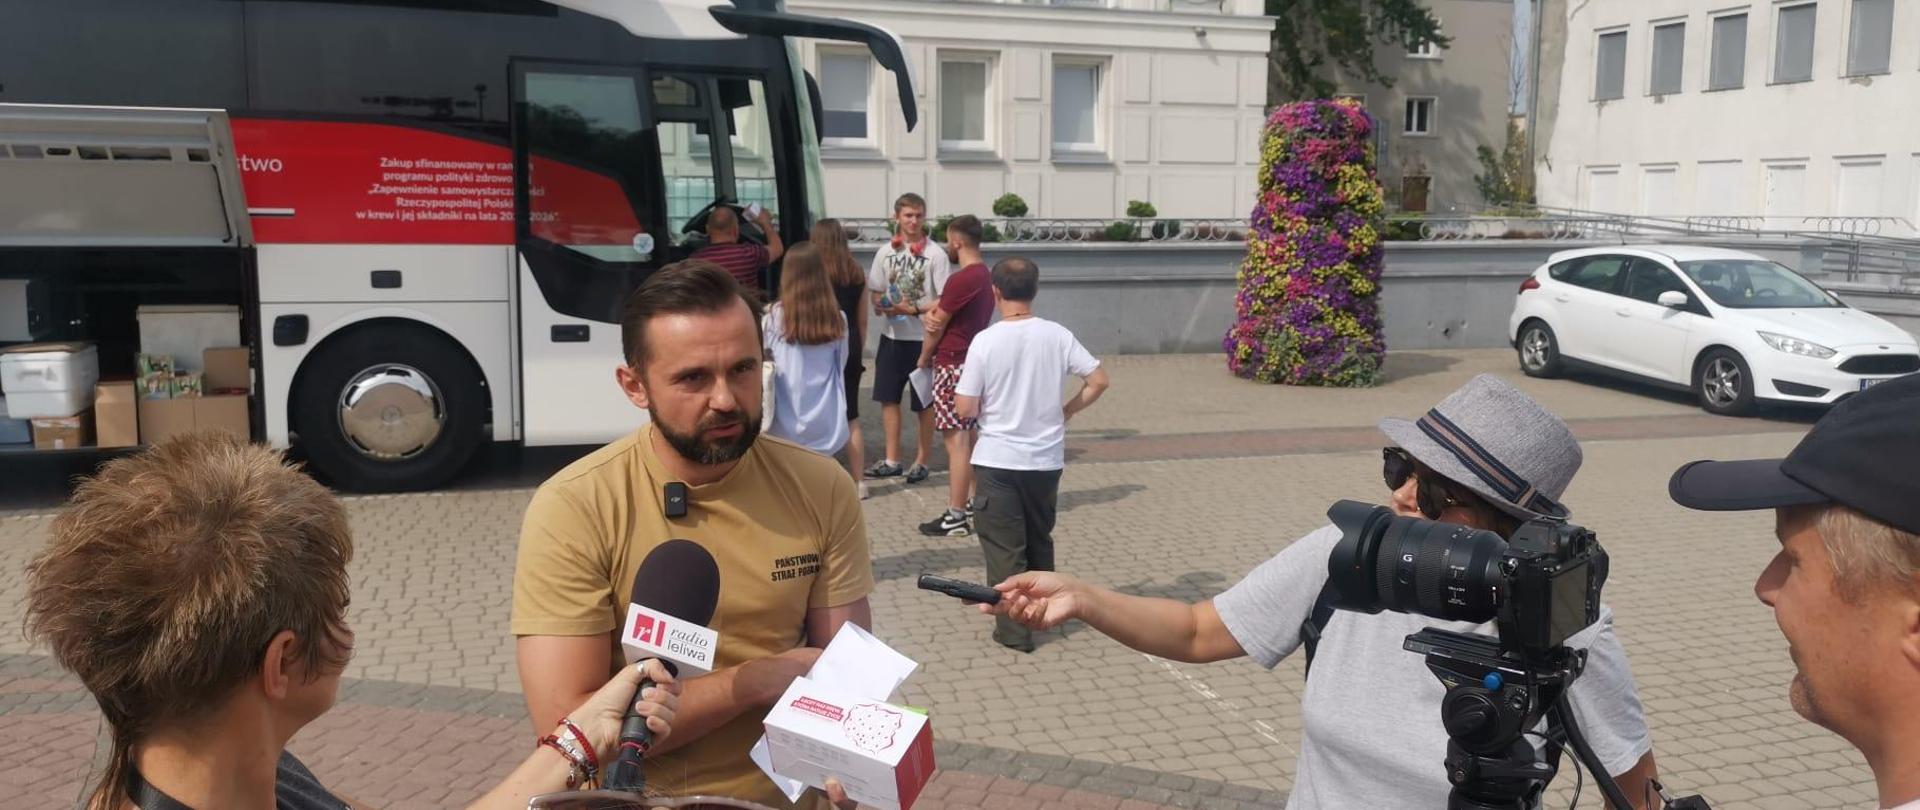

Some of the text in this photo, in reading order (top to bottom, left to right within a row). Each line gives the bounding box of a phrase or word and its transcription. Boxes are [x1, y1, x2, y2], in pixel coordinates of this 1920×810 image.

[380, 157, 413, 169] Zakup
[415, 158, 483, 170] sfinansowany
[486, 161, 495, 170] w
[383, 172, 433, 182] programu
[435, 171, 474, 183] polityki
[396, 197, 514, 209] Rzeczypospolitej Polski
[356, 210, 365, 219] w
[367, 209, 394, 219] krew
[397, 209, 400, 219] i
[401, 209, 415, 221] jej
[417, 209, 462, 221] składniki
[464, 212, 477, 221] na
[479, 210, 498, 221] lata
[885, 254, 930, 274] TMNT
[775, 554, 819, 568] PAŃSTWOW
[1403, 554, 1413, 562] G
[771, 569, 795, 581] STRAŻ
[670, 628, 708, 648] radio
[667, 640, 705, 661] leliwa
